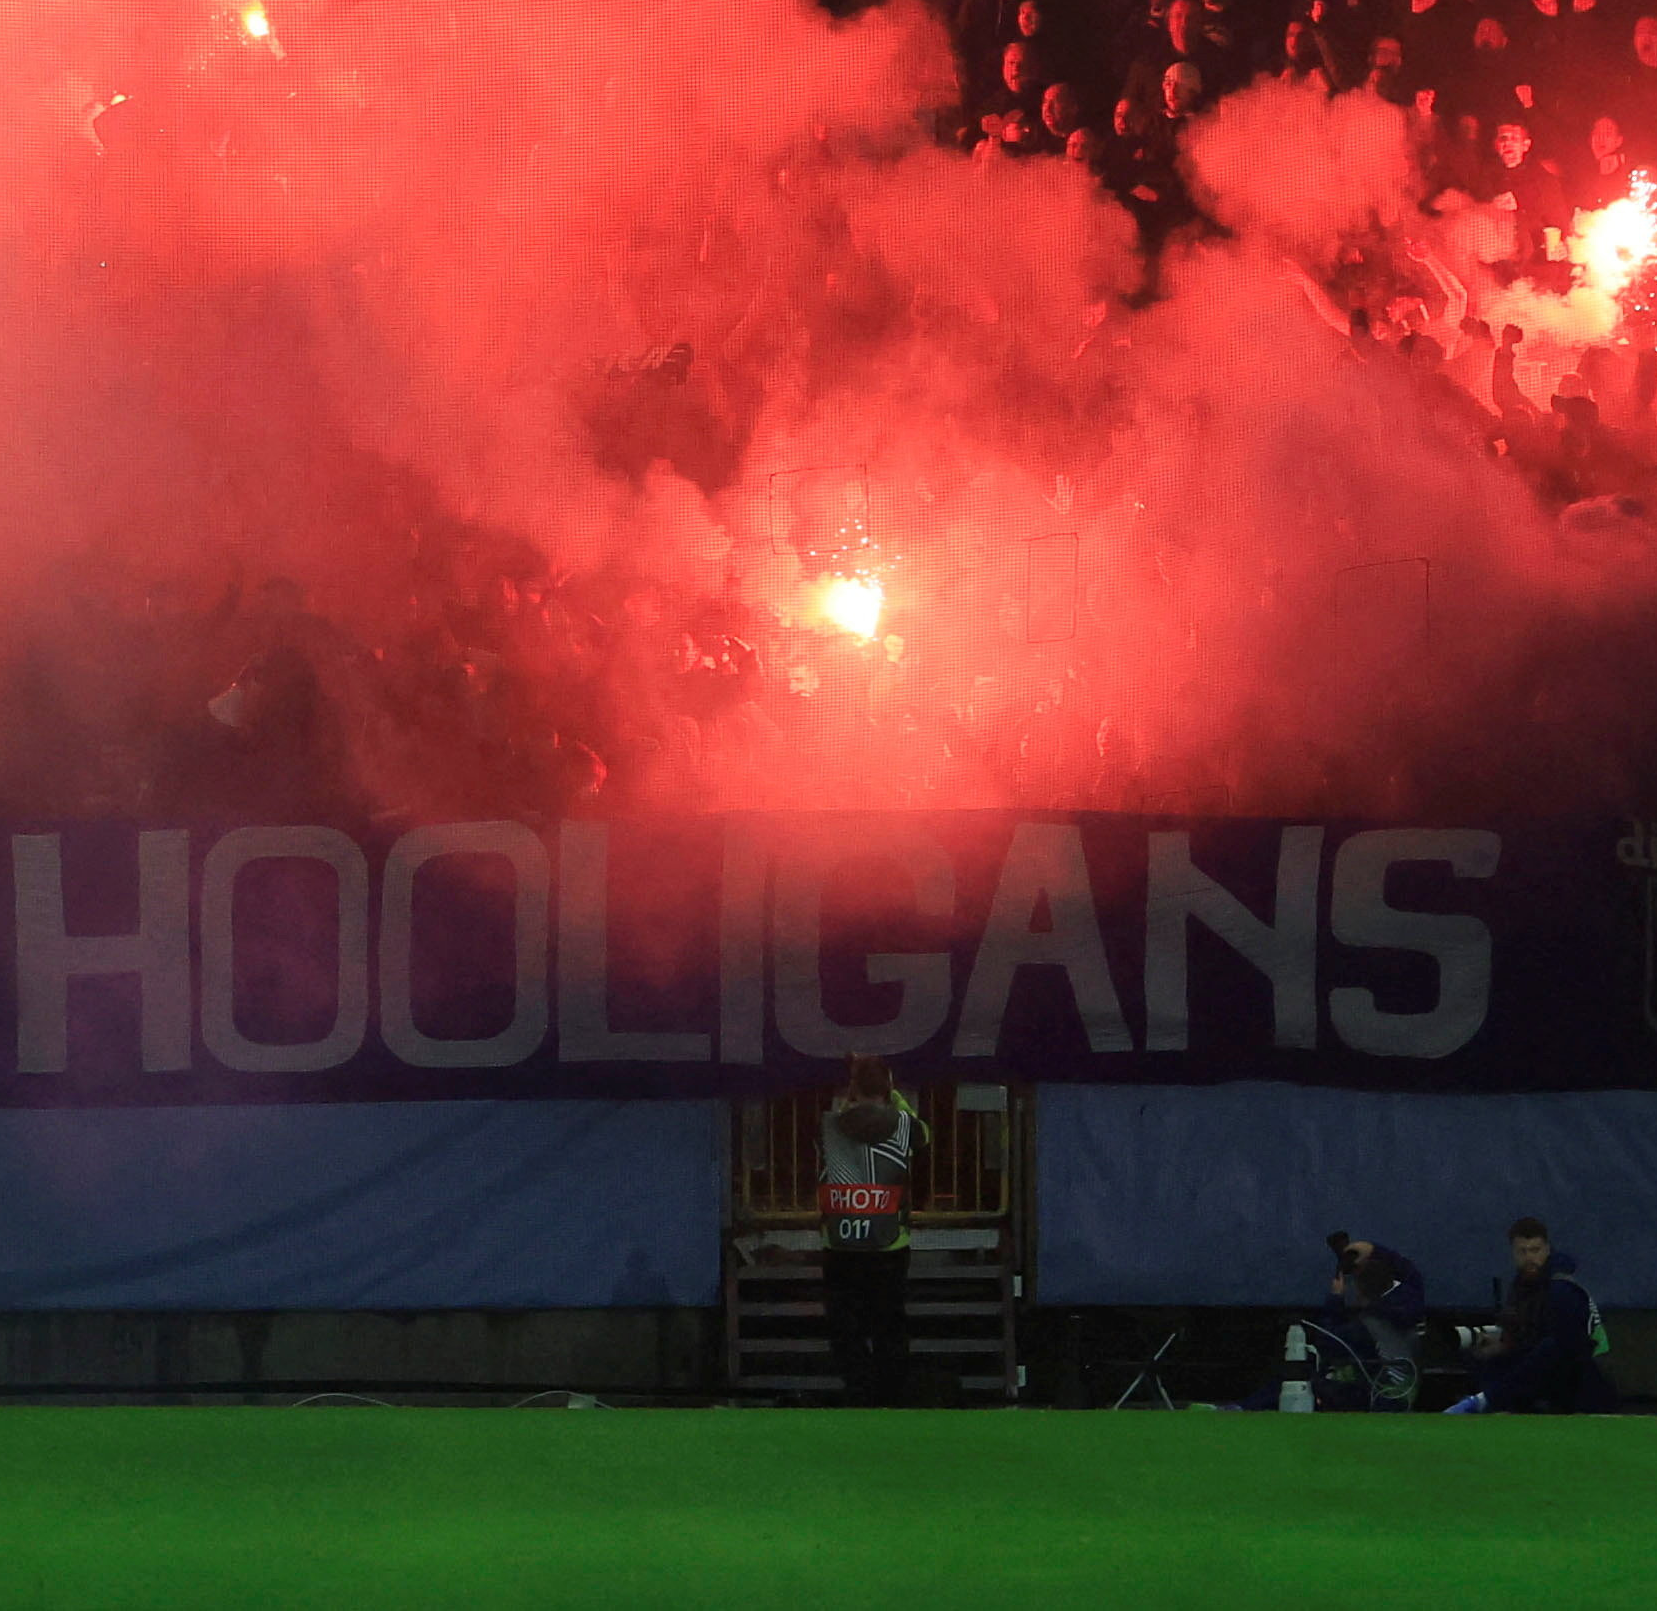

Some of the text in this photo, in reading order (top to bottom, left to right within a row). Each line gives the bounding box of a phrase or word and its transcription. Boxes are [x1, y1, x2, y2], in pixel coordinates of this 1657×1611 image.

[10, 819, 1502, 1075] HOOLIGANS
[830, 1188, 891, 1209] PHOTO
[839, 1218, 871, 1240] 011
